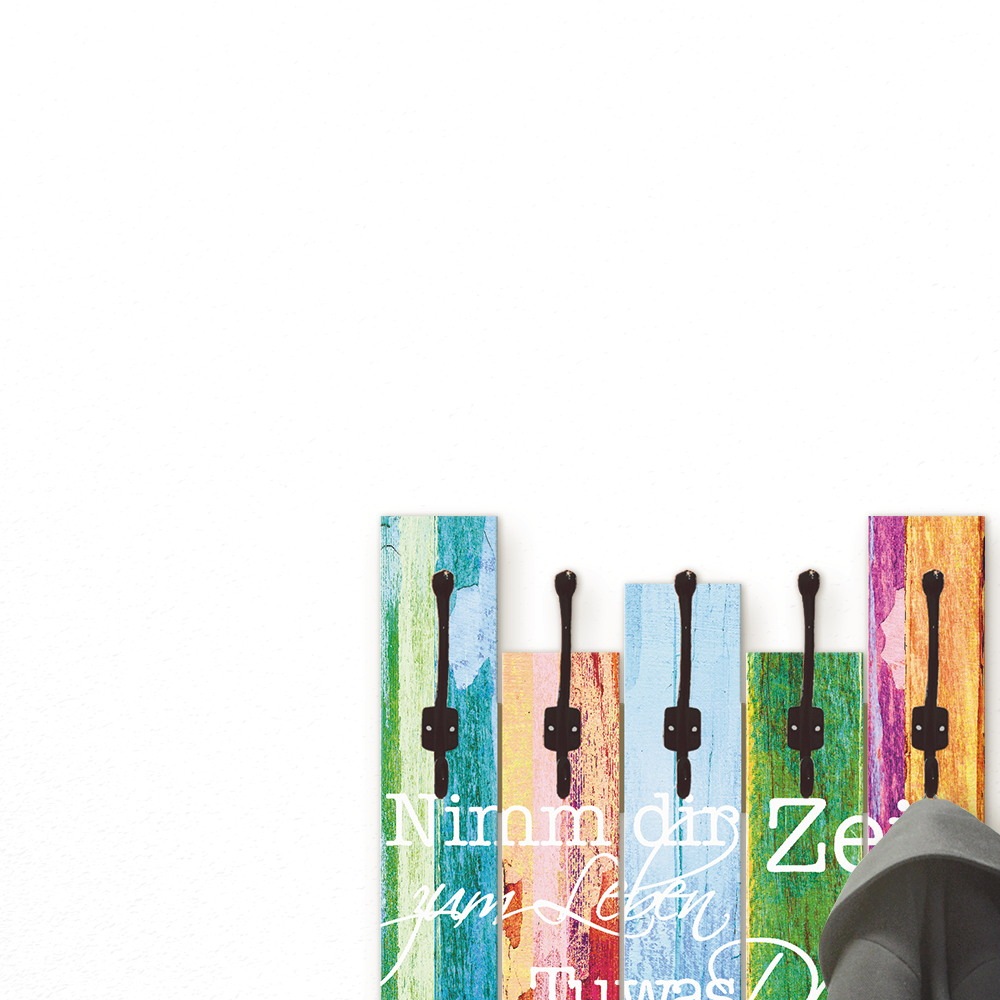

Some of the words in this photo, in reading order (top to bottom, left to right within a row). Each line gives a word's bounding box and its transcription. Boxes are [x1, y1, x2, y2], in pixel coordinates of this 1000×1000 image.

[385, 793, 612, 847] Nimm
[633, 793, 740, 847] dir
[501, 806, 739, 941] Leben
